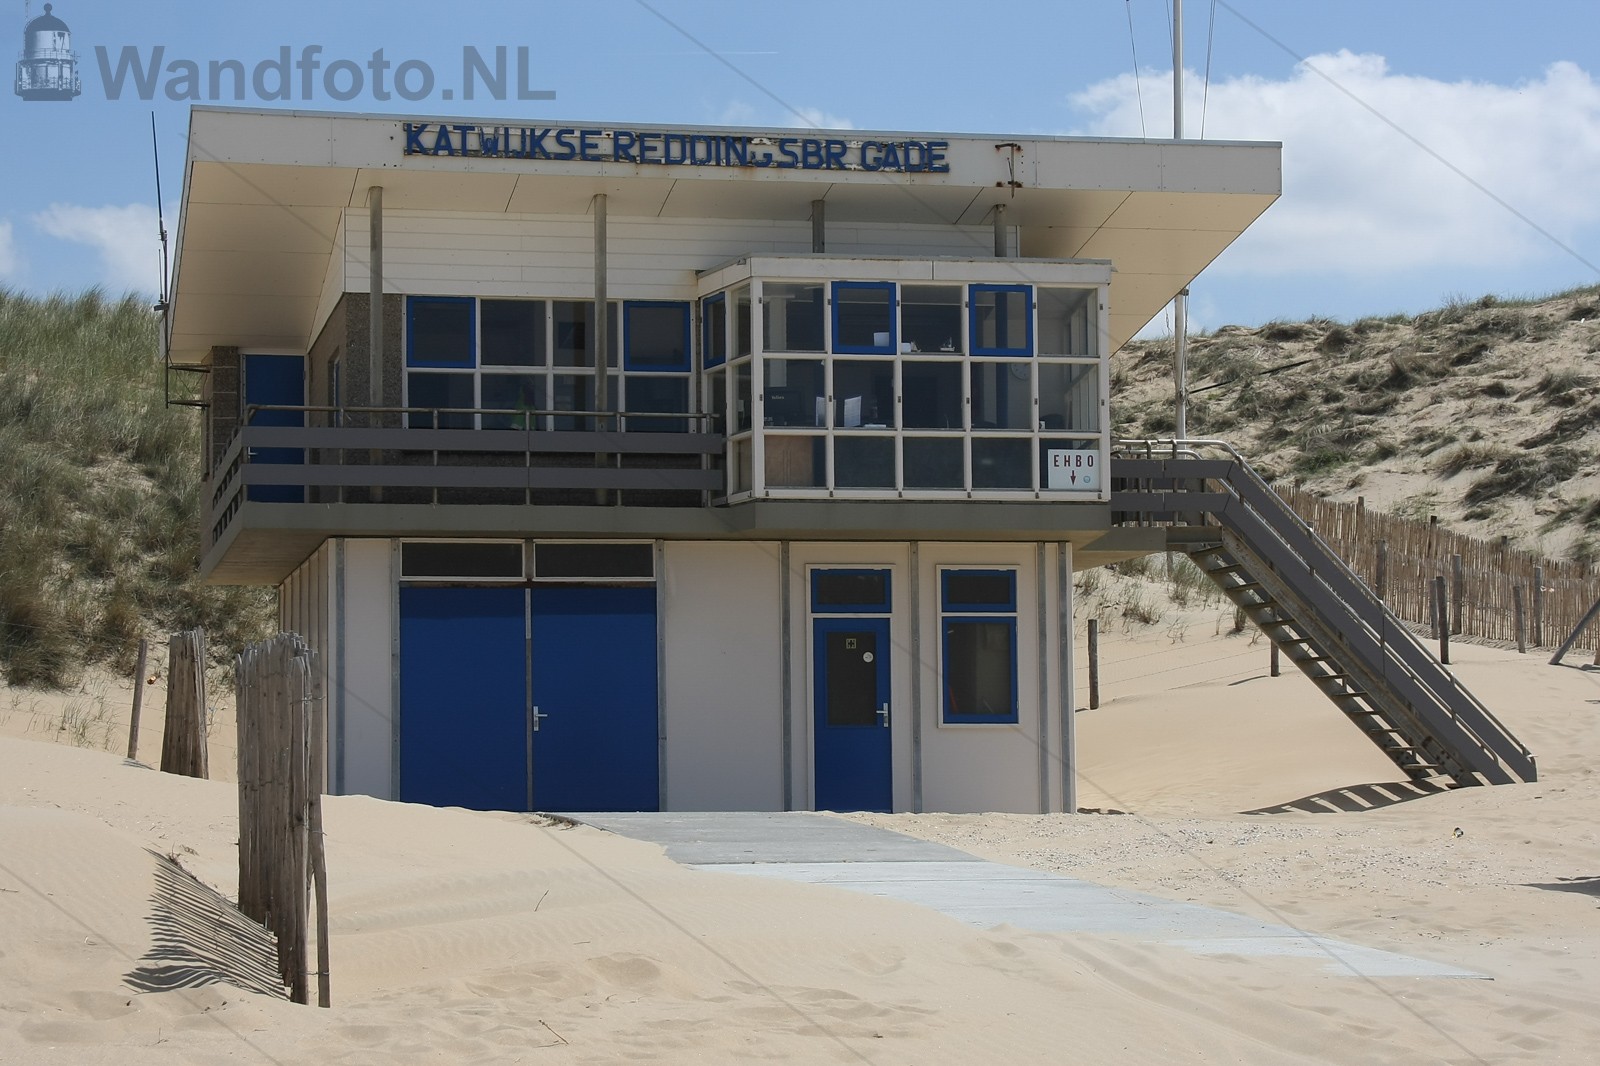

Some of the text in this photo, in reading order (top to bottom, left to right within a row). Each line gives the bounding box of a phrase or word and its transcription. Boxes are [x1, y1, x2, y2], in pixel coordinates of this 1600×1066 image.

[406, 122, 950, 173] KATWIJKSE REDDINGSBRGADE
[1053, 454, 1094, 468] EHBO
